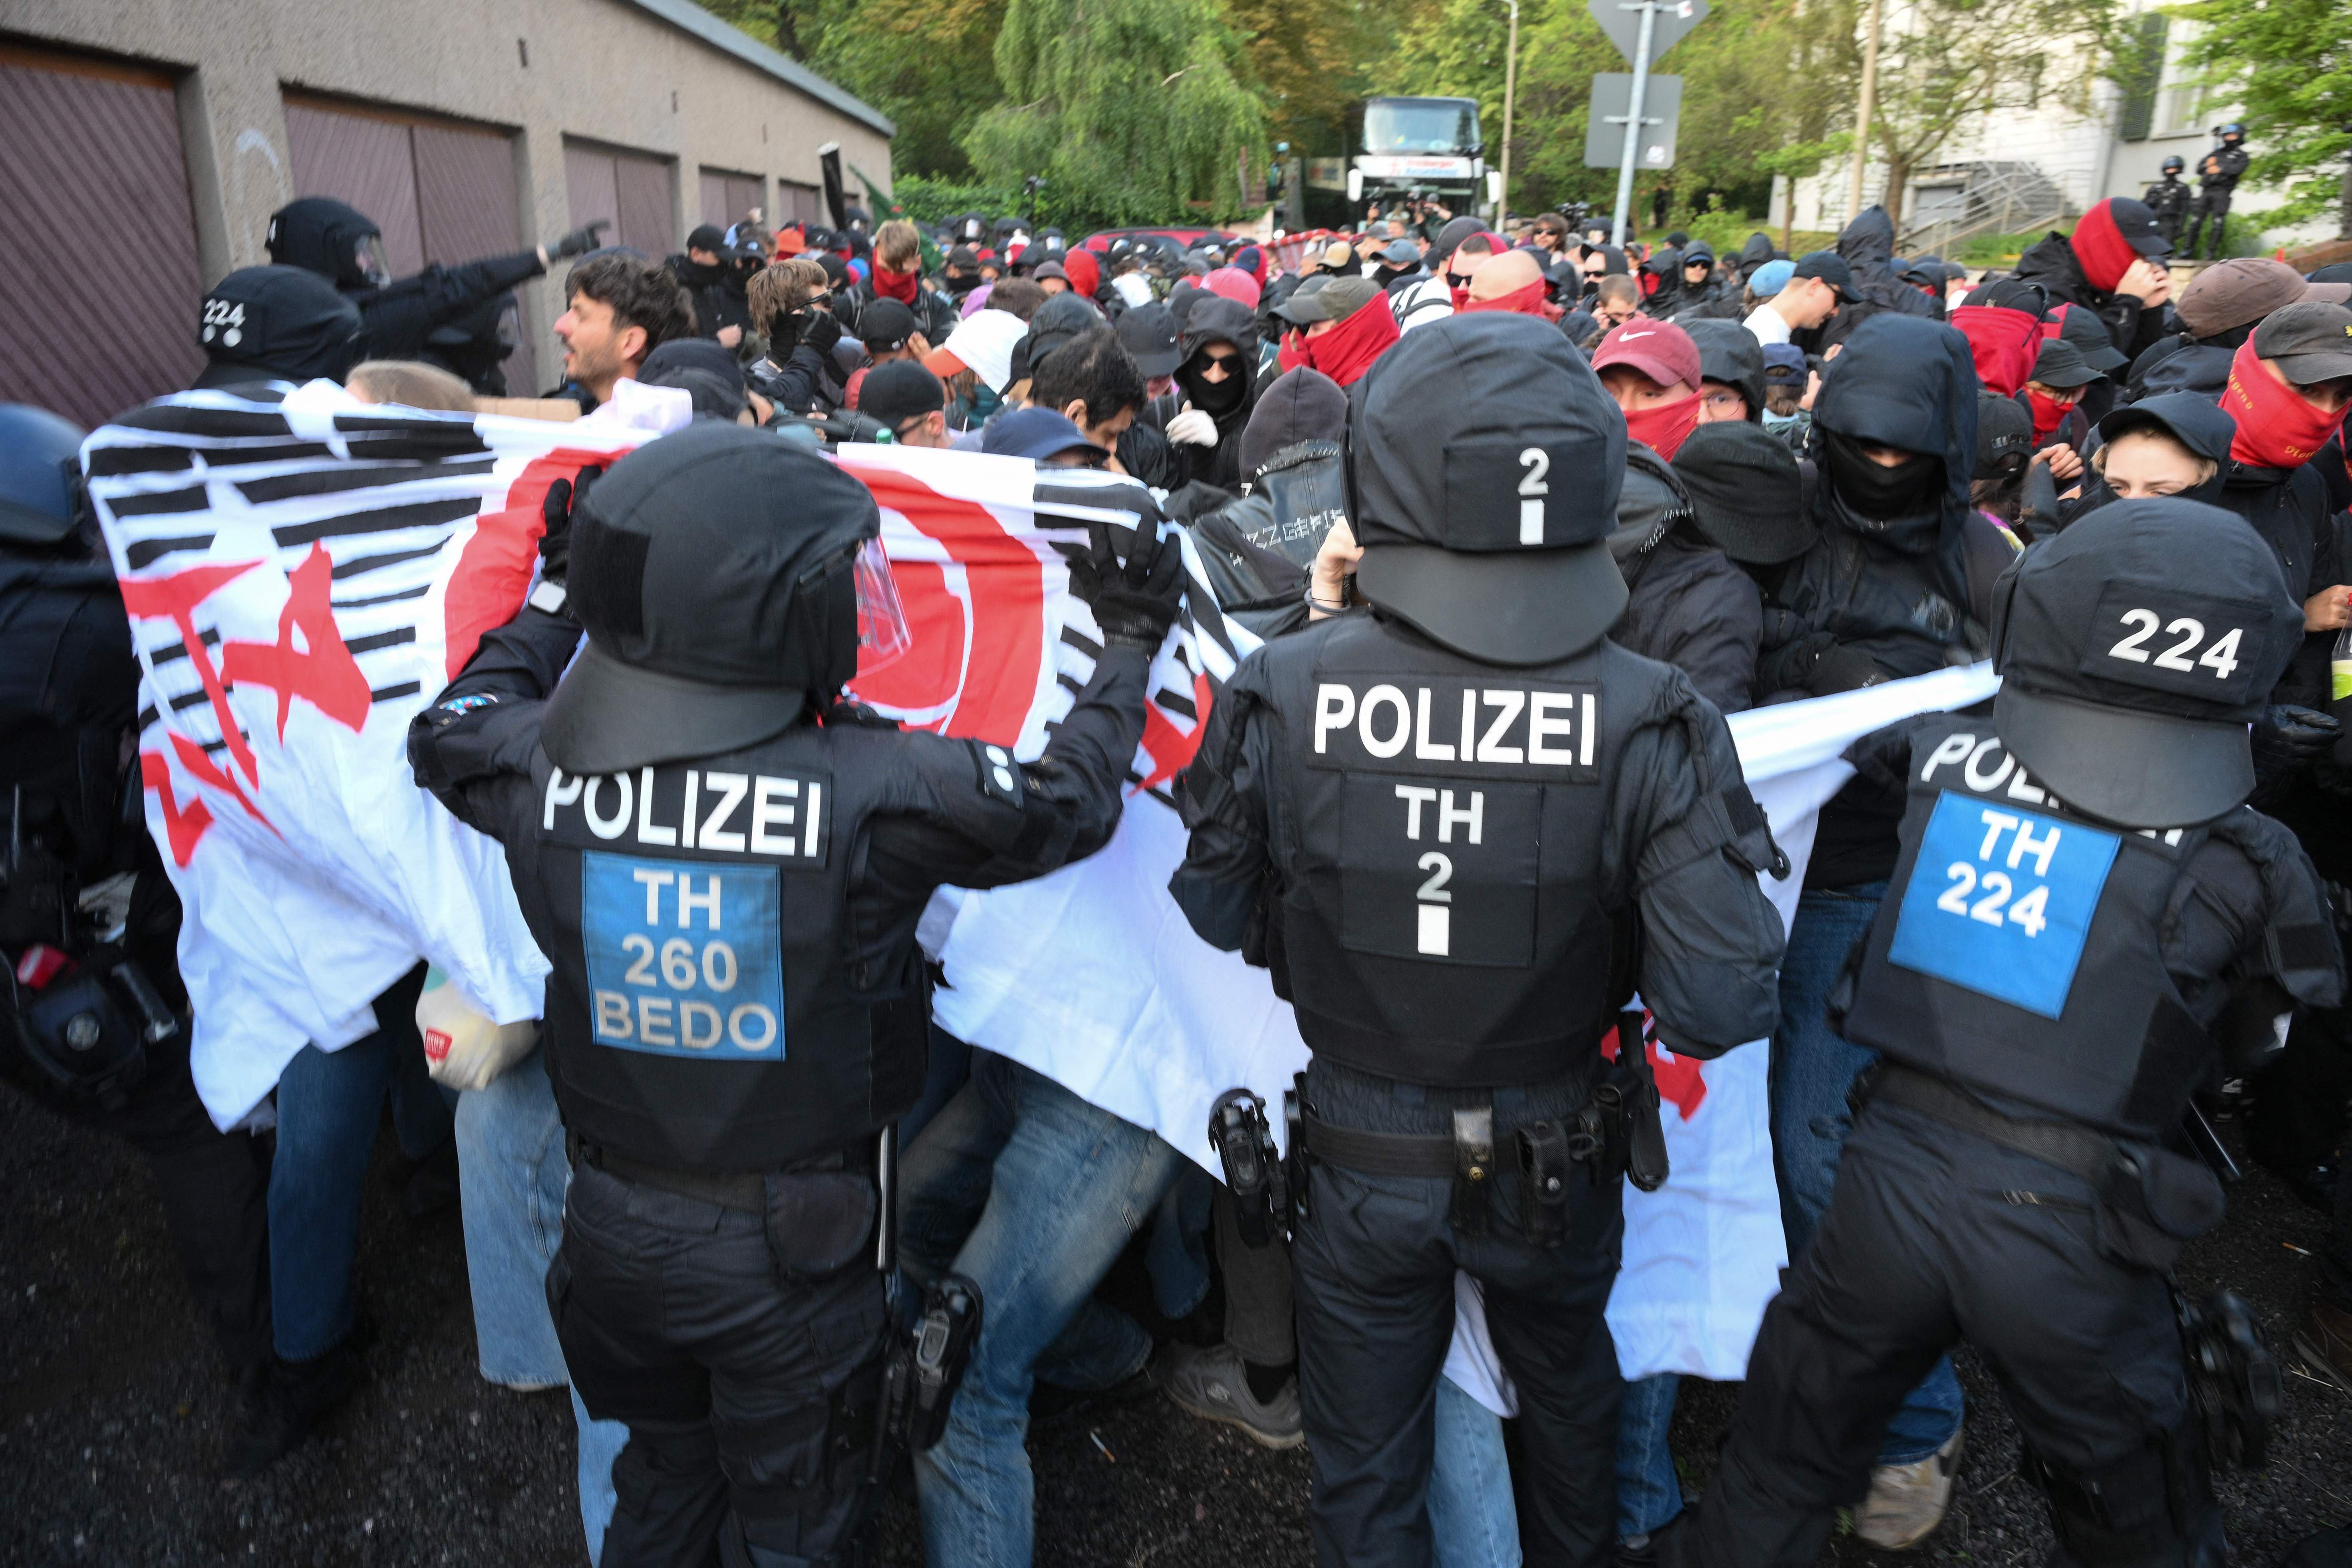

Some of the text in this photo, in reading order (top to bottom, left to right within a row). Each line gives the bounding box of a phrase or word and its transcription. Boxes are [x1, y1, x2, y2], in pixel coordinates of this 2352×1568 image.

[204, 299, 245, 328] 224
[1518, 447, 1549, 496] 2
[2108, 608, 2243, 679] 224
[1314, 683, 1595, 766] POLIZEI
[543, 765, 821, 857] POLIZEI
[1395, 784, 1484, 845] TH
[1979, 809, 2062, 878] TH
[634, 867, 721, 930] TH
[1416, 851, 1453, 903] 2
[1937, 861, 2050, 939] 224
[622, 934, 737, 992] 260
[595, 990, 777, 1051] BEDO
